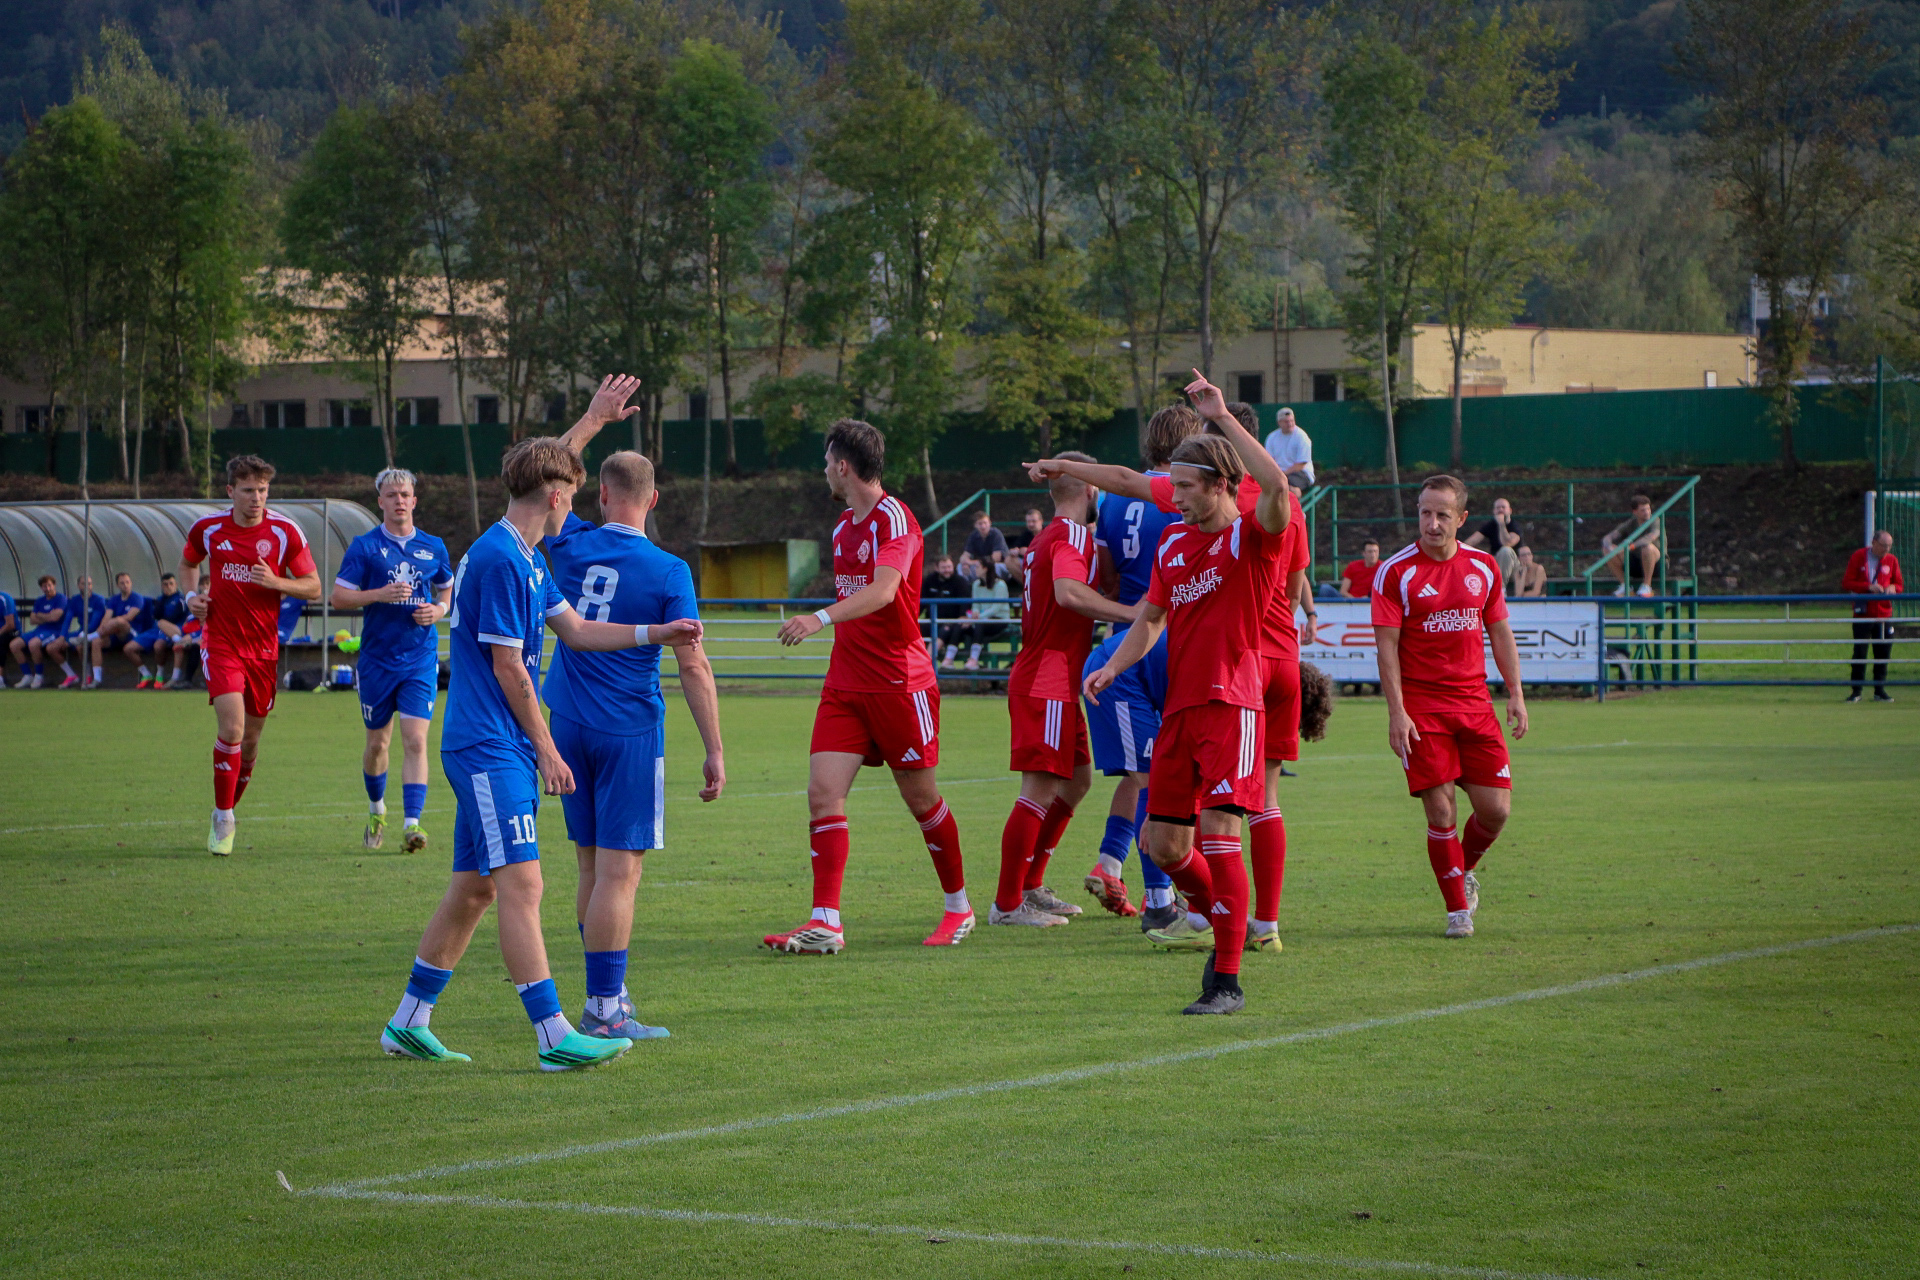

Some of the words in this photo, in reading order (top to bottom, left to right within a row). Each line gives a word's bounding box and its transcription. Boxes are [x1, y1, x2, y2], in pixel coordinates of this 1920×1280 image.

[1122, 501, 1145, 559] 3
[576, 565, 620, 623] 8
[1423, 620, 1480, 633] TEAMSPORT
[1427, 607, 1480, 621] ABSOLUTE
[362, 703, 373, 722] 17
[508, 814, 536, 846] 10
